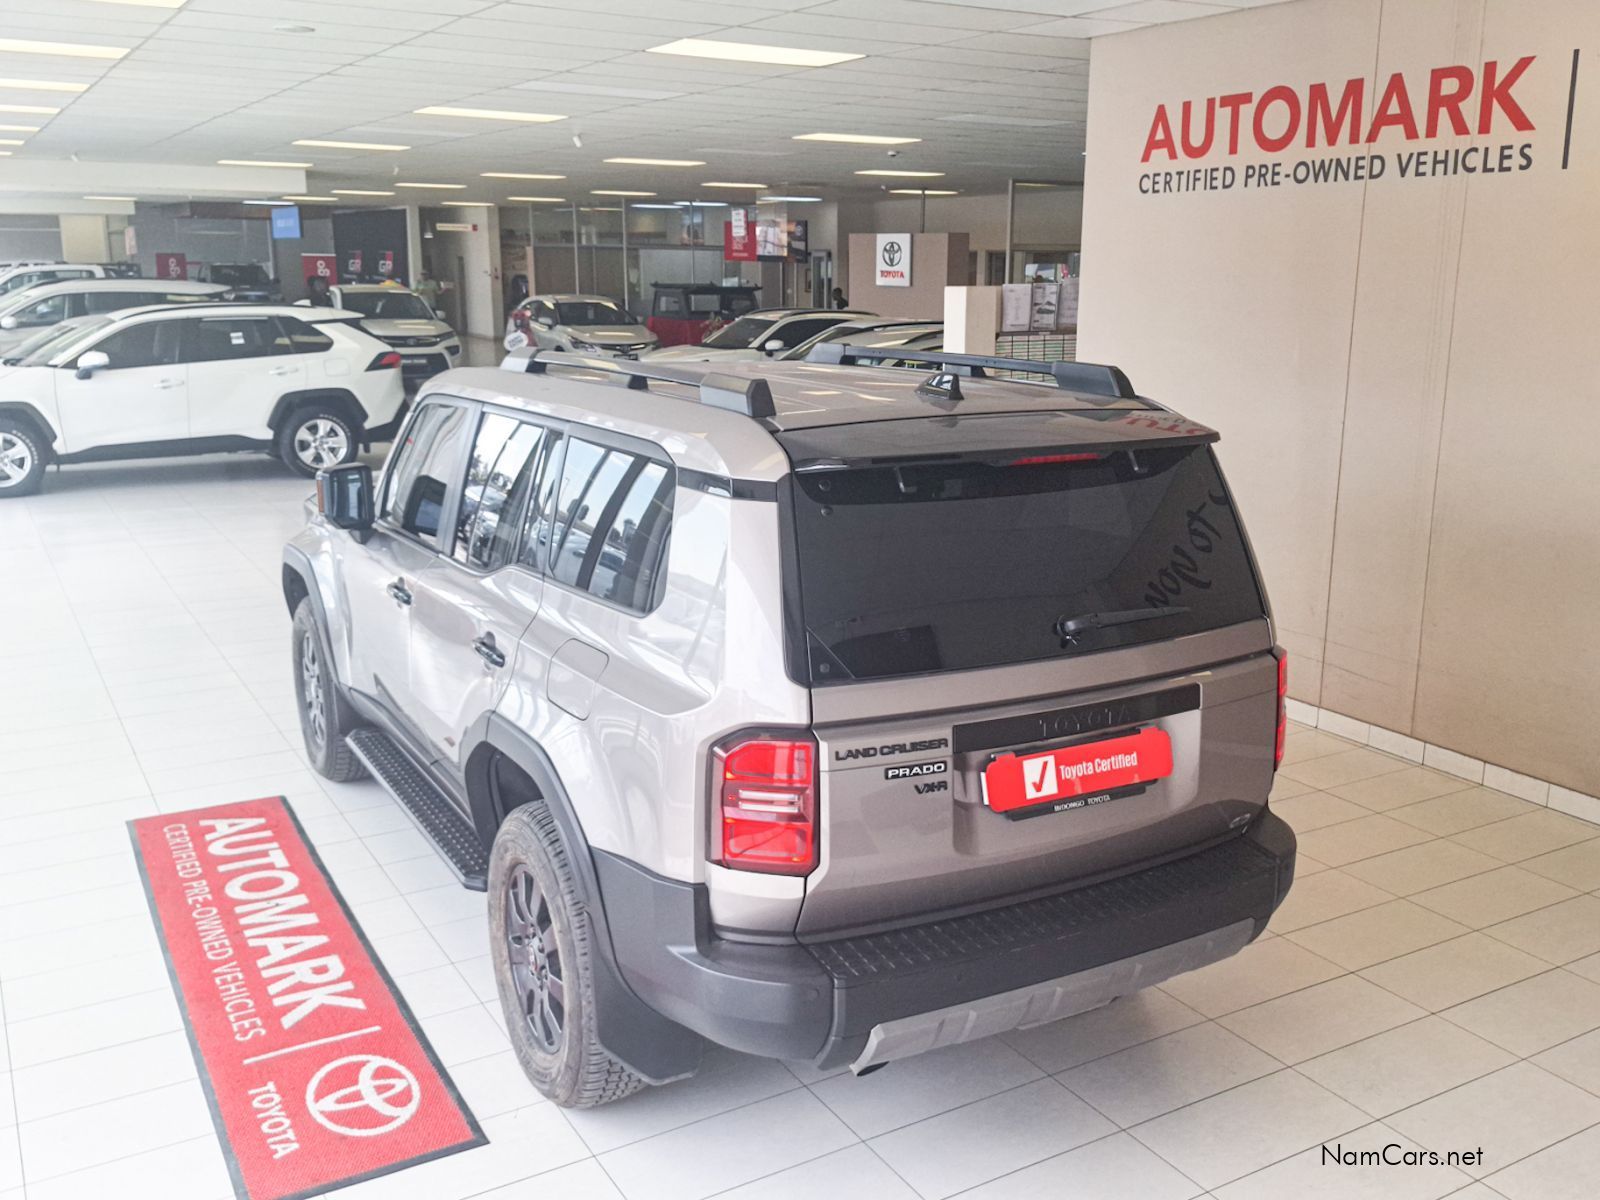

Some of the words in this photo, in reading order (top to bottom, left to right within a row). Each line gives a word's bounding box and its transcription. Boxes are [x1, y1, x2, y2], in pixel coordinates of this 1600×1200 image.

[1141, 56, 1537, 163] AUTOMARK
[1139, 166, 1236, 194] CERTIFIED
[1244, 155, 1386, 188] PRE-OWNED
[1397, 143, 1533, 178] VEHICLES
[880, 270, 904, 279] TOYOTA
[1040, 704, 1133, 737] TOYOTA
[835, 746, 878, 761] LAND
[879, 738, 949, 756] CRUISER
[887, 762, 946, 779] PRADO
[1060, 761, 1096, 780] Toyota
[1094, 752, 1138, 773] Certified
[1087, 794, 1111, 805] TOYOTA
[162, 823, 203, 879] CERTIFIED
[182, 879, 234, 961] PRE-OWNED
[199, 817, 367, 1029] AUTOMARK
[211, 960, 266, 1042] VEHICLES
[248, 1081, 300, 1160] TOYOTA
